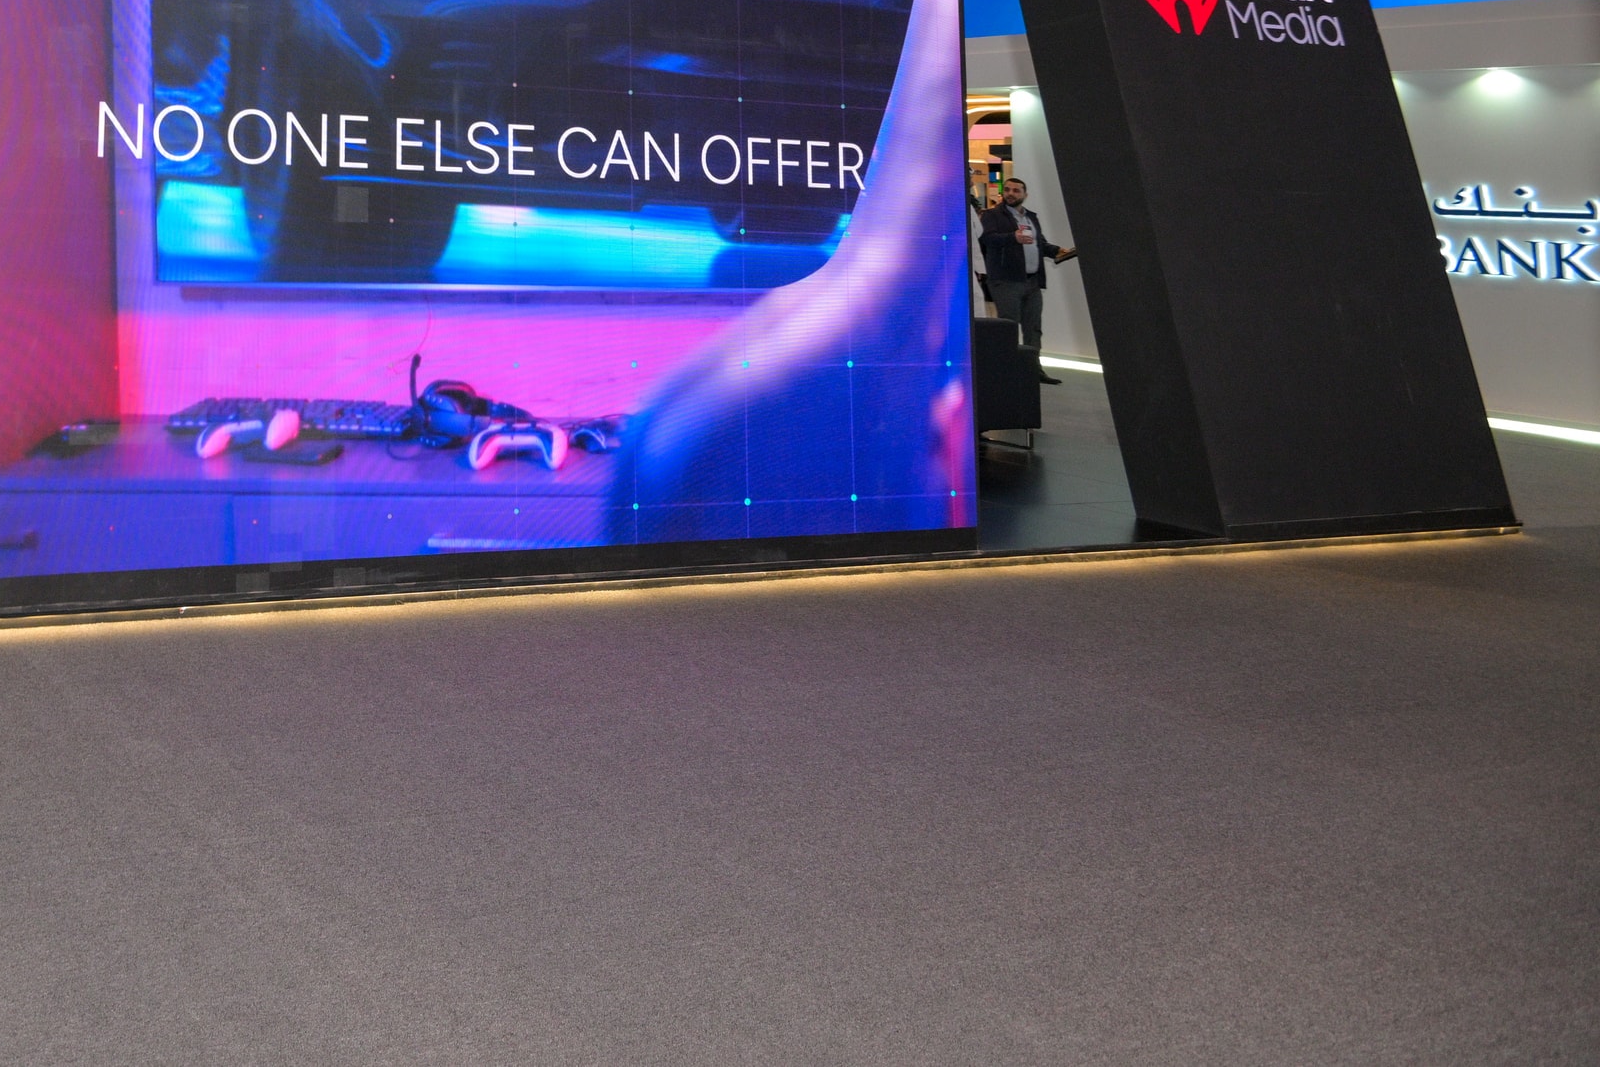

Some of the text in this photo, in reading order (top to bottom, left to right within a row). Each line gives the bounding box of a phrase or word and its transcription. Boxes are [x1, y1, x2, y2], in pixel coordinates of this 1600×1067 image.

[1225, 0, 1346, 47] Media
[95, 100, 866, 190] NO ONE ELSE CAN OFFER
